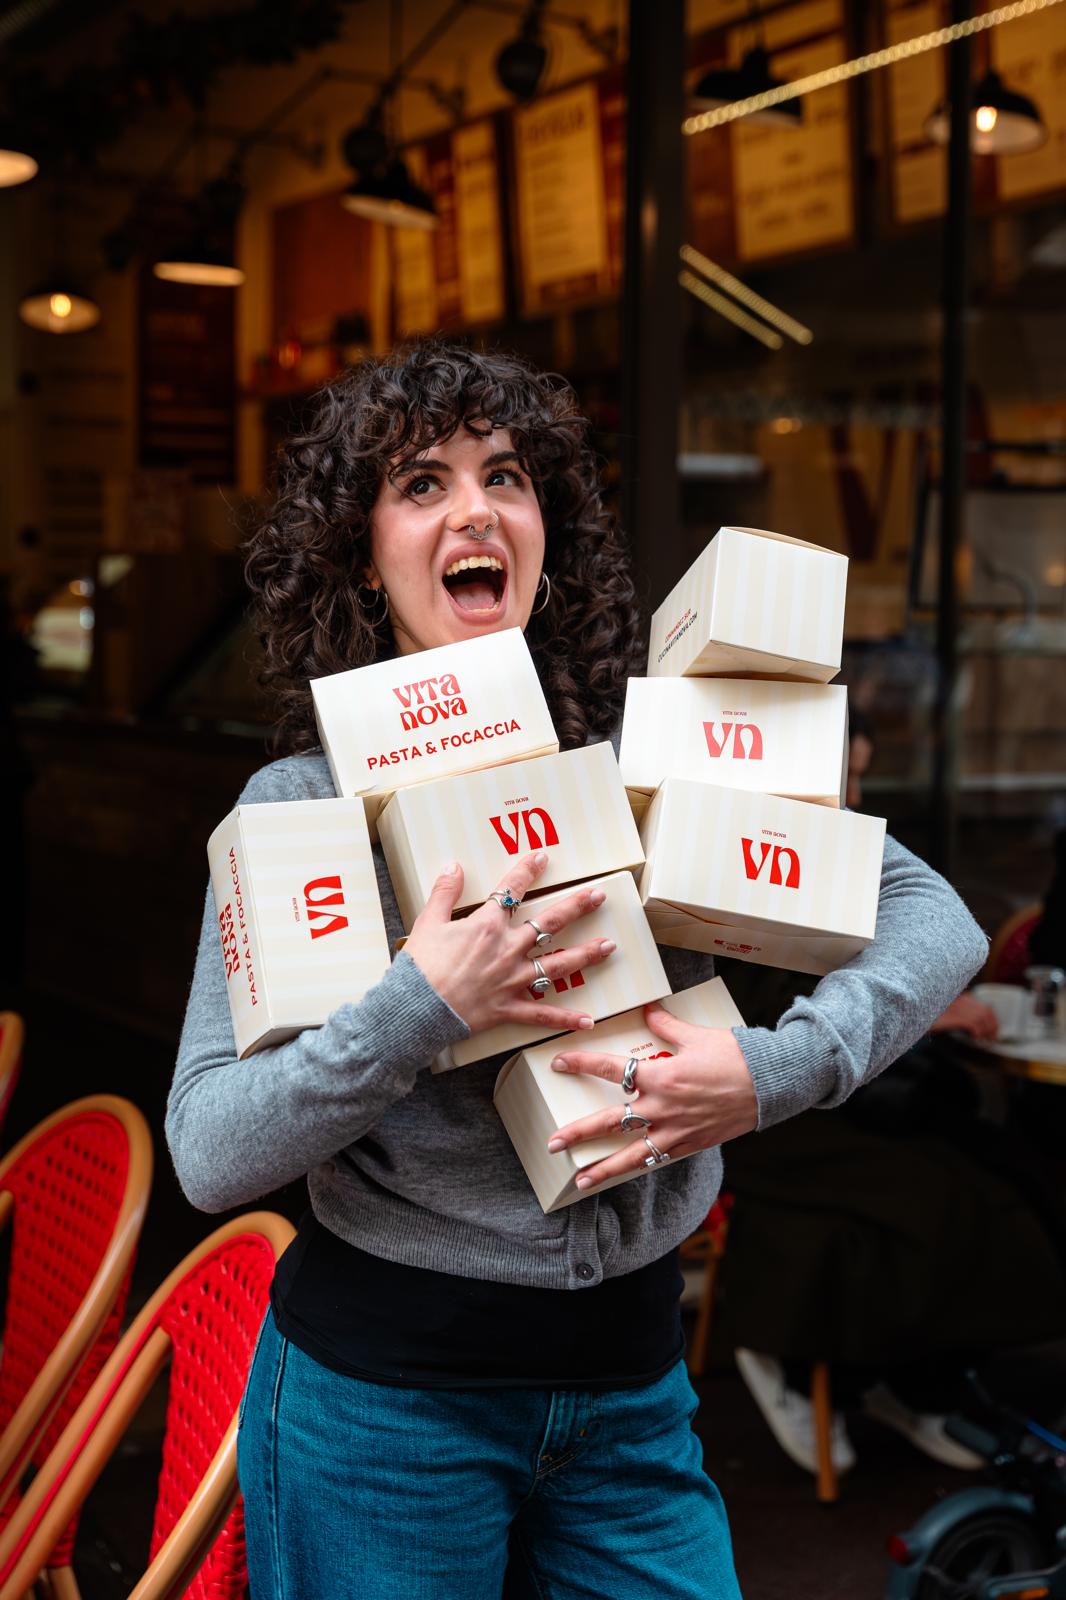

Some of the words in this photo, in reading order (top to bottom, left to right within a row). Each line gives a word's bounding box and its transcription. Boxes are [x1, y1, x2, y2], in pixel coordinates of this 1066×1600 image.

[367, 746, 422, 770] PASTA
[425, 741, 437, 755] &
[440, 718, 521, 750] FOCACCIA
[229, 846, 246, 929] FOCACCIA
[242, 932, 249, 944] &
[245, 948, 258, 1006] PASTA
